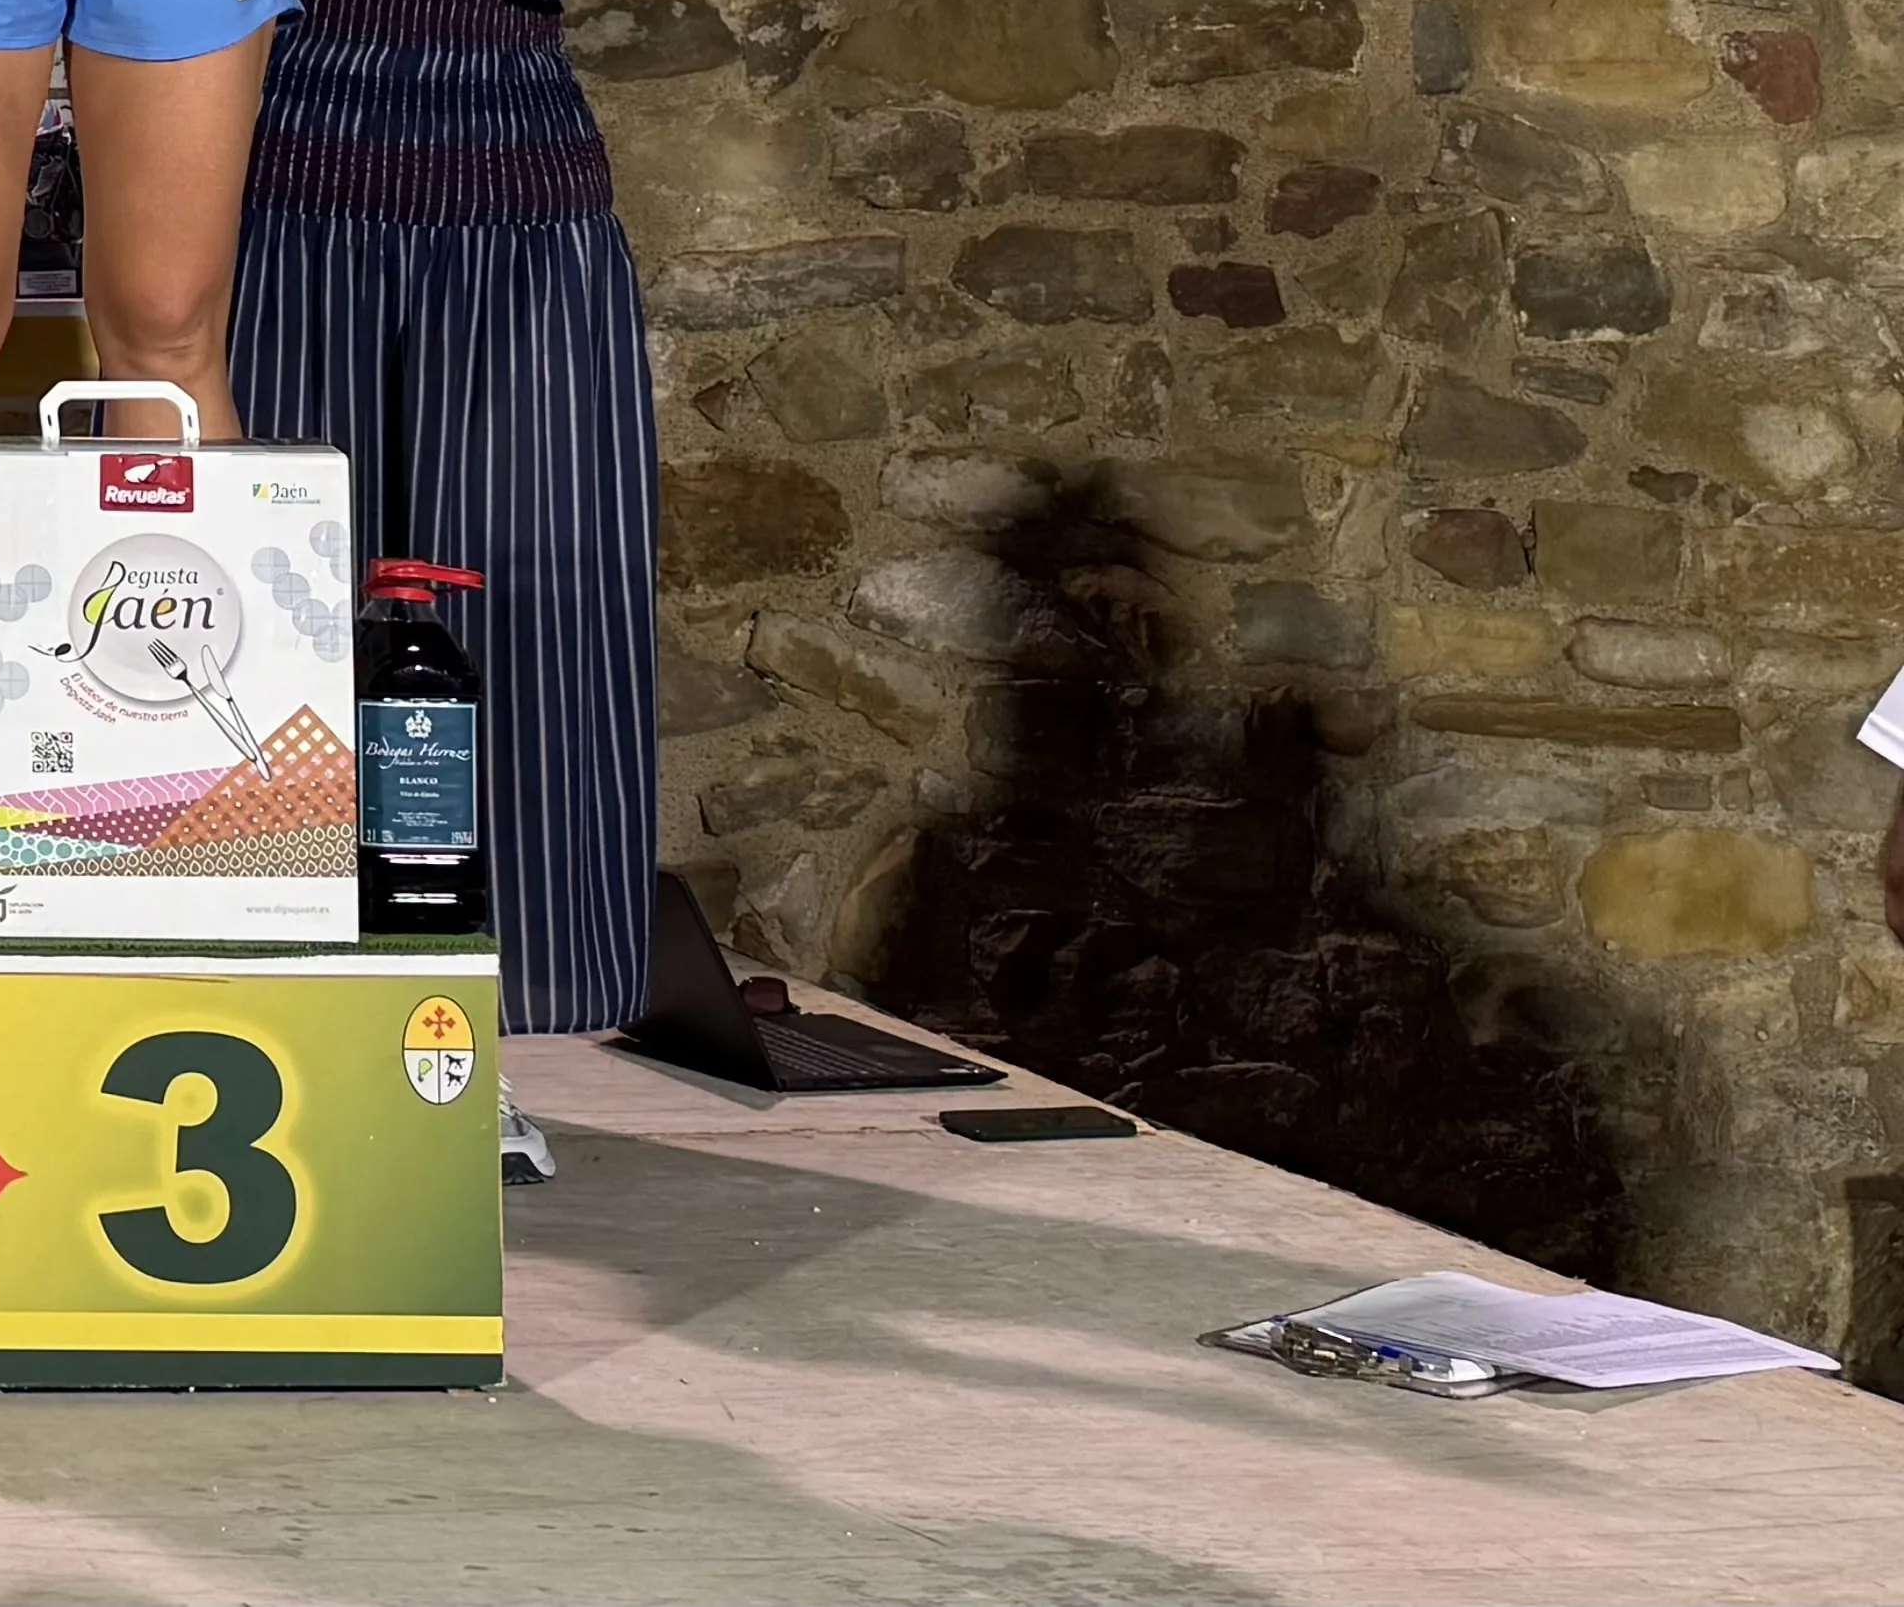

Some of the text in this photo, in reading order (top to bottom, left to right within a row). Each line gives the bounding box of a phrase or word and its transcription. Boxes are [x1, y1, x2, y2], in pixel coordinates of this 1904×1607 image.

[105, 485, 186, 504] Revueltas
[271, 482, 308, 498] Jaén
[101, 560, 199, 589] Degusta
[76, 588, 215, 661] Jaén
[98, 1031, 297, 1285] 3
